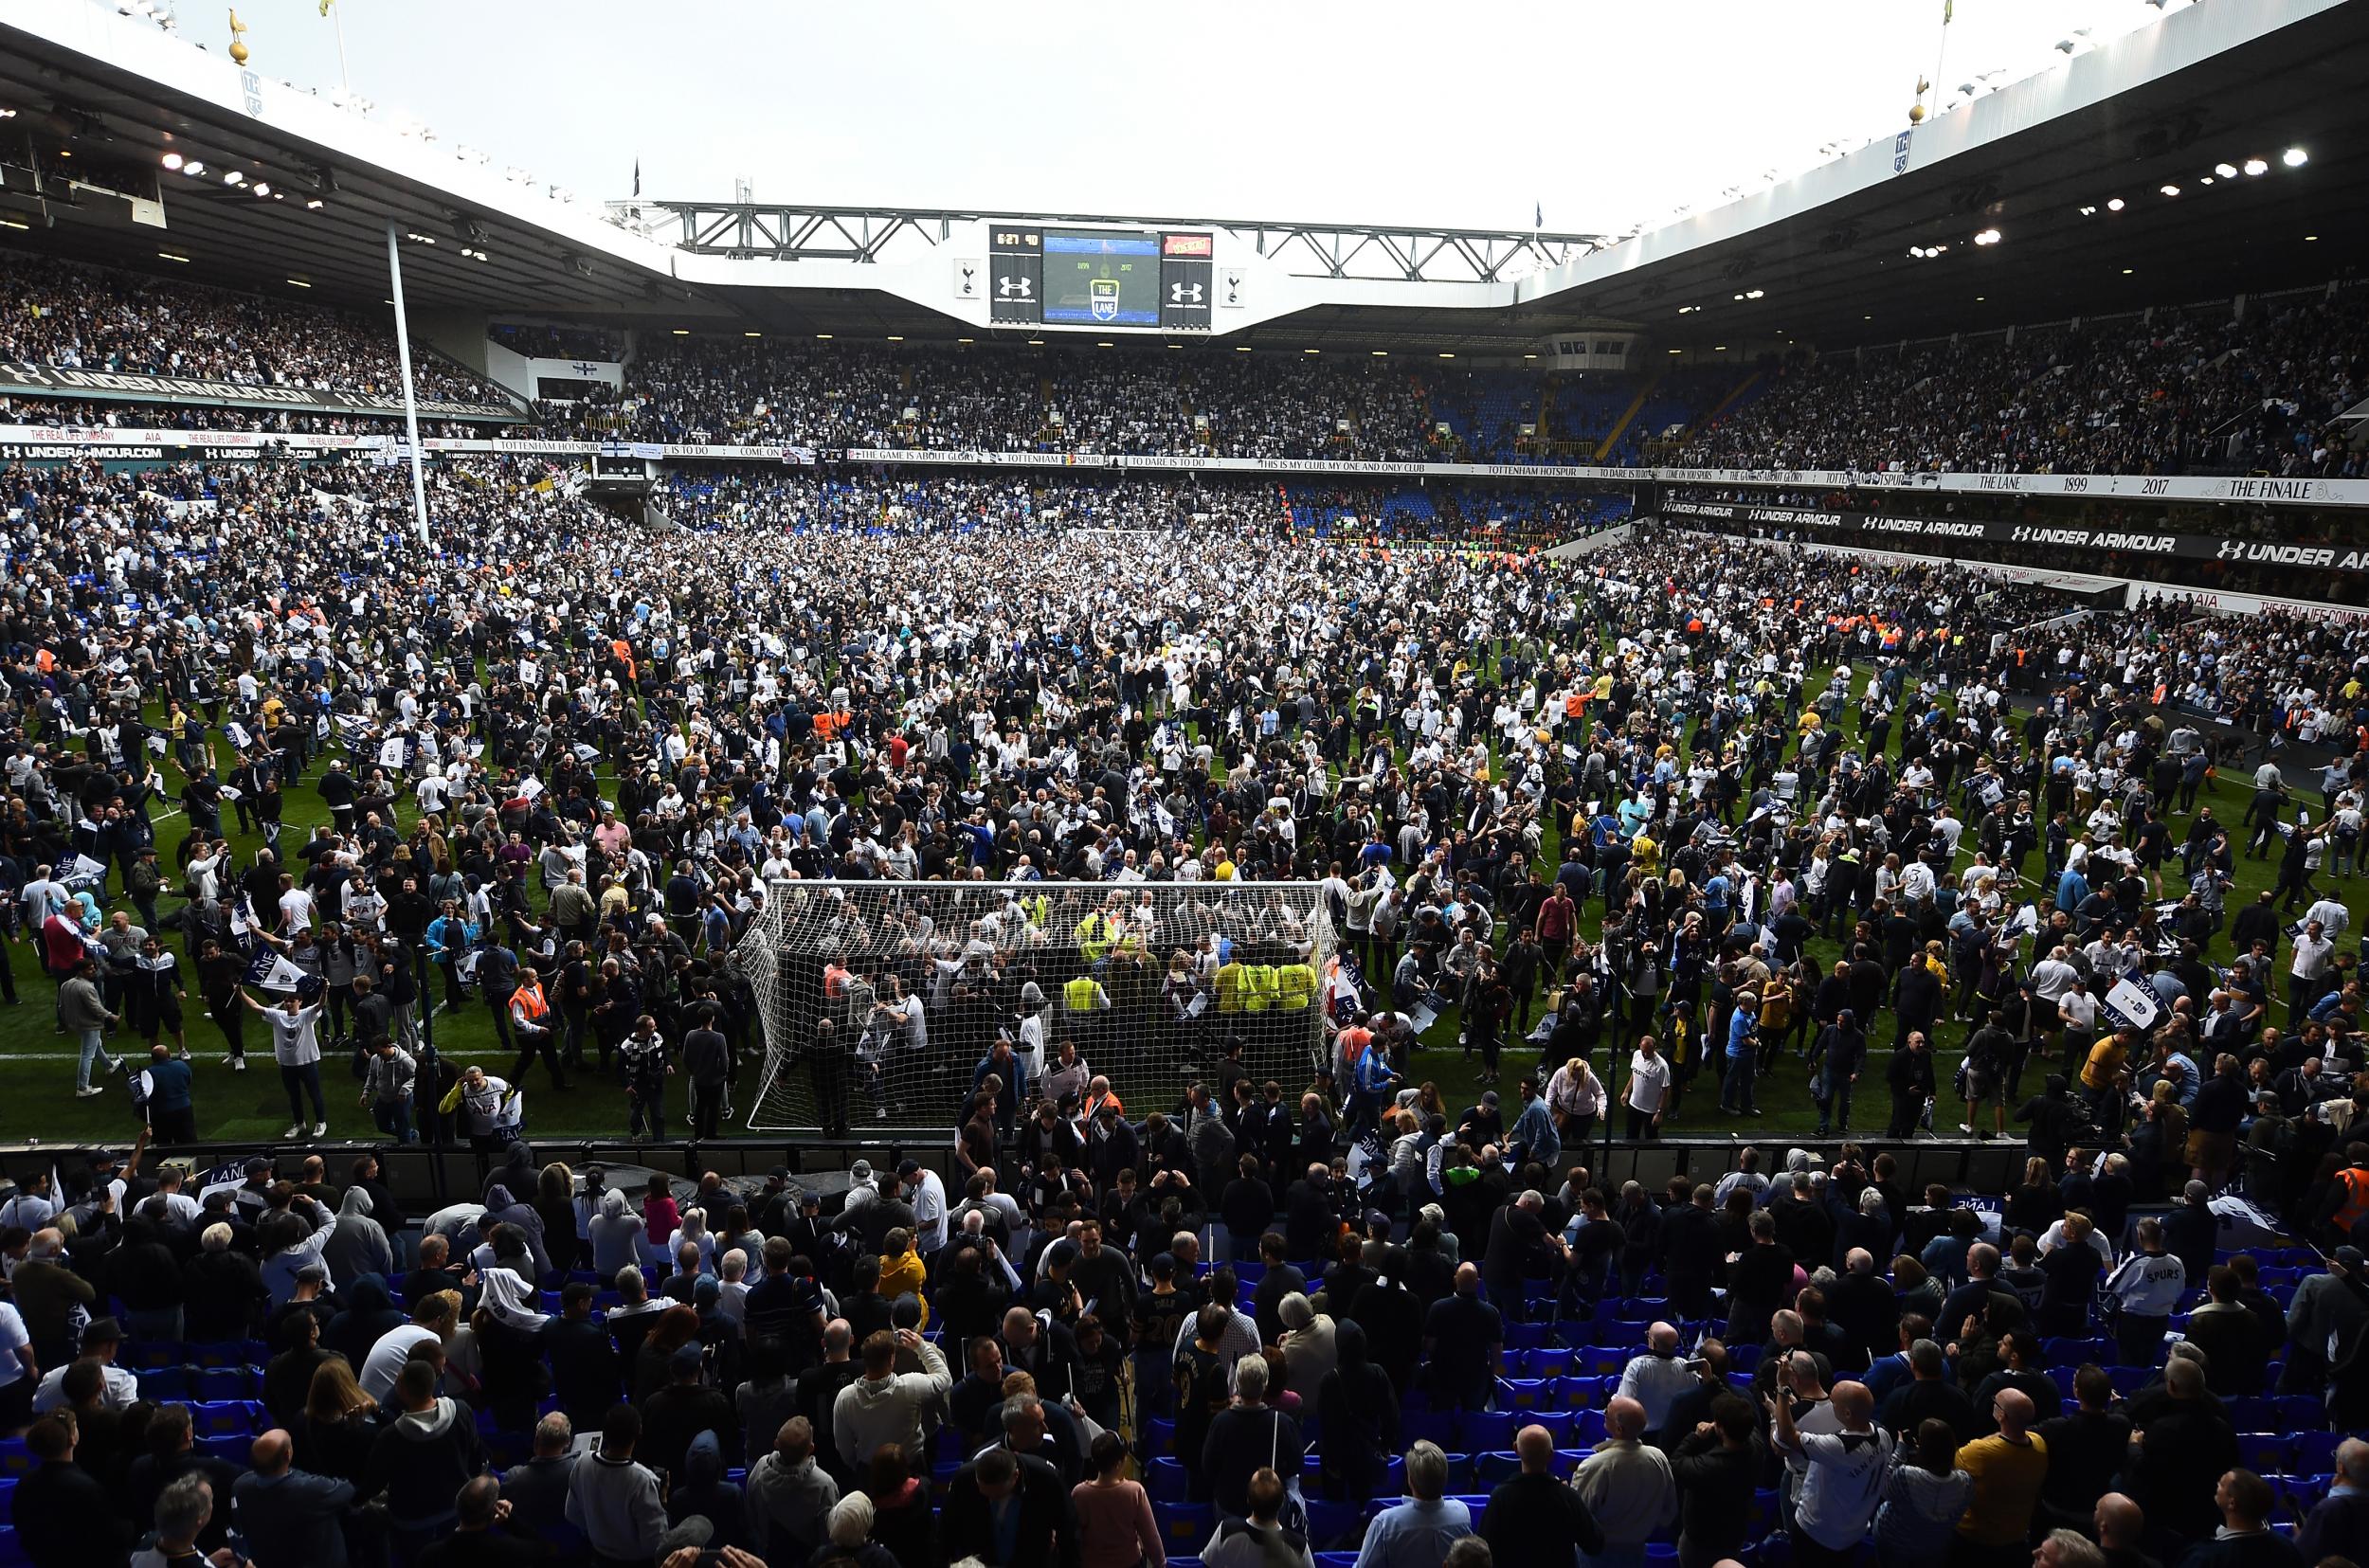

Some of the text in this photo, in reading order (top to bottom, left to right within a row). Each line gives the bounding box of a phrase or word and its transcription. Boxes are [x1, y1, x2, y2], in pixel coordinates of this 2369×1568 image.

[1897, 135, 1908, 152] TH
[1895, 157, 1906, 170] FC
[1097, 284, 1112, 296] THE
[1094, 301, 1114, 314] LANE
[51, 369, 319, 405] UNDERARMOUR.COM
[30, 430, 45, 441] THE
[45, 430, 65, 442] REAL
[81, 430, 115, 442] COMPANY
[145, 432, 162, 442] AIA
[226, 435, 251, 445] COMPANY
[499, 441, 555, 451] TOTTENHAM
[557, 442, 599, 452] HOTSPUR
[671, 445, 679, 455] IS
[682, 445, 693, 455] TO
[696, 446, 709, 455] DO
[740, 447, 779, 457] COME ON
[861, 450, 975, 461] THE GAME IS ABOUT GLORY
[1008, 454, 1058, 463] TOTTENHAM
[1132, 457, 1205, 467] TO DARE IS TO DO
[1259, 460, 1278, 469] THIS
[1279, 460, 1288, 469] IS
[1289, 460, 1303, 470] MY
[1328, 461, 1342, 471] MY
[1343, 462, 1359, 471] ONE
[1362, 462, 1380, 471] AND
[1382, 462, 1403, 472] ONLY
[1404, 463, 1425, 472] CLUB
[1488, 466, 1577, 477] TOTTENHAM HOTSPUR
[1611, 469, 1627, 478] DARE
[1628, 469, 1635, 478] IS
[1783, 472, 1802, 483] GLORY
[1980, 477, 2021, 490] THE LANE
[2064, 478, 2088, 492] 1899
[2142, 479, 2169, 495] 2017
[2230, 480, 2313, 499] THE FINALE
[1671, 503, 1697, 514] UNDER
[1761, 511, 1794, 522] UNDER
[1878, 518, 1923, 532] UNDER
[2032, 528, 2089, 545] UNDER
[2247, 543, 2335, 567] UNDER
[2194, 593, 2217, 608] AIA
[2080, 775, 2089, 787] 10
[1637, 841, 1644, 853] 11
[1908, 869, 1921, 882] 3
[249, 951, 278, 984] LANE
[473, 1104, 497, 1116] AIA
[2147, 1269, 2179, 1283] SPURS
[1148, 1313, 1183, 1343] 20
